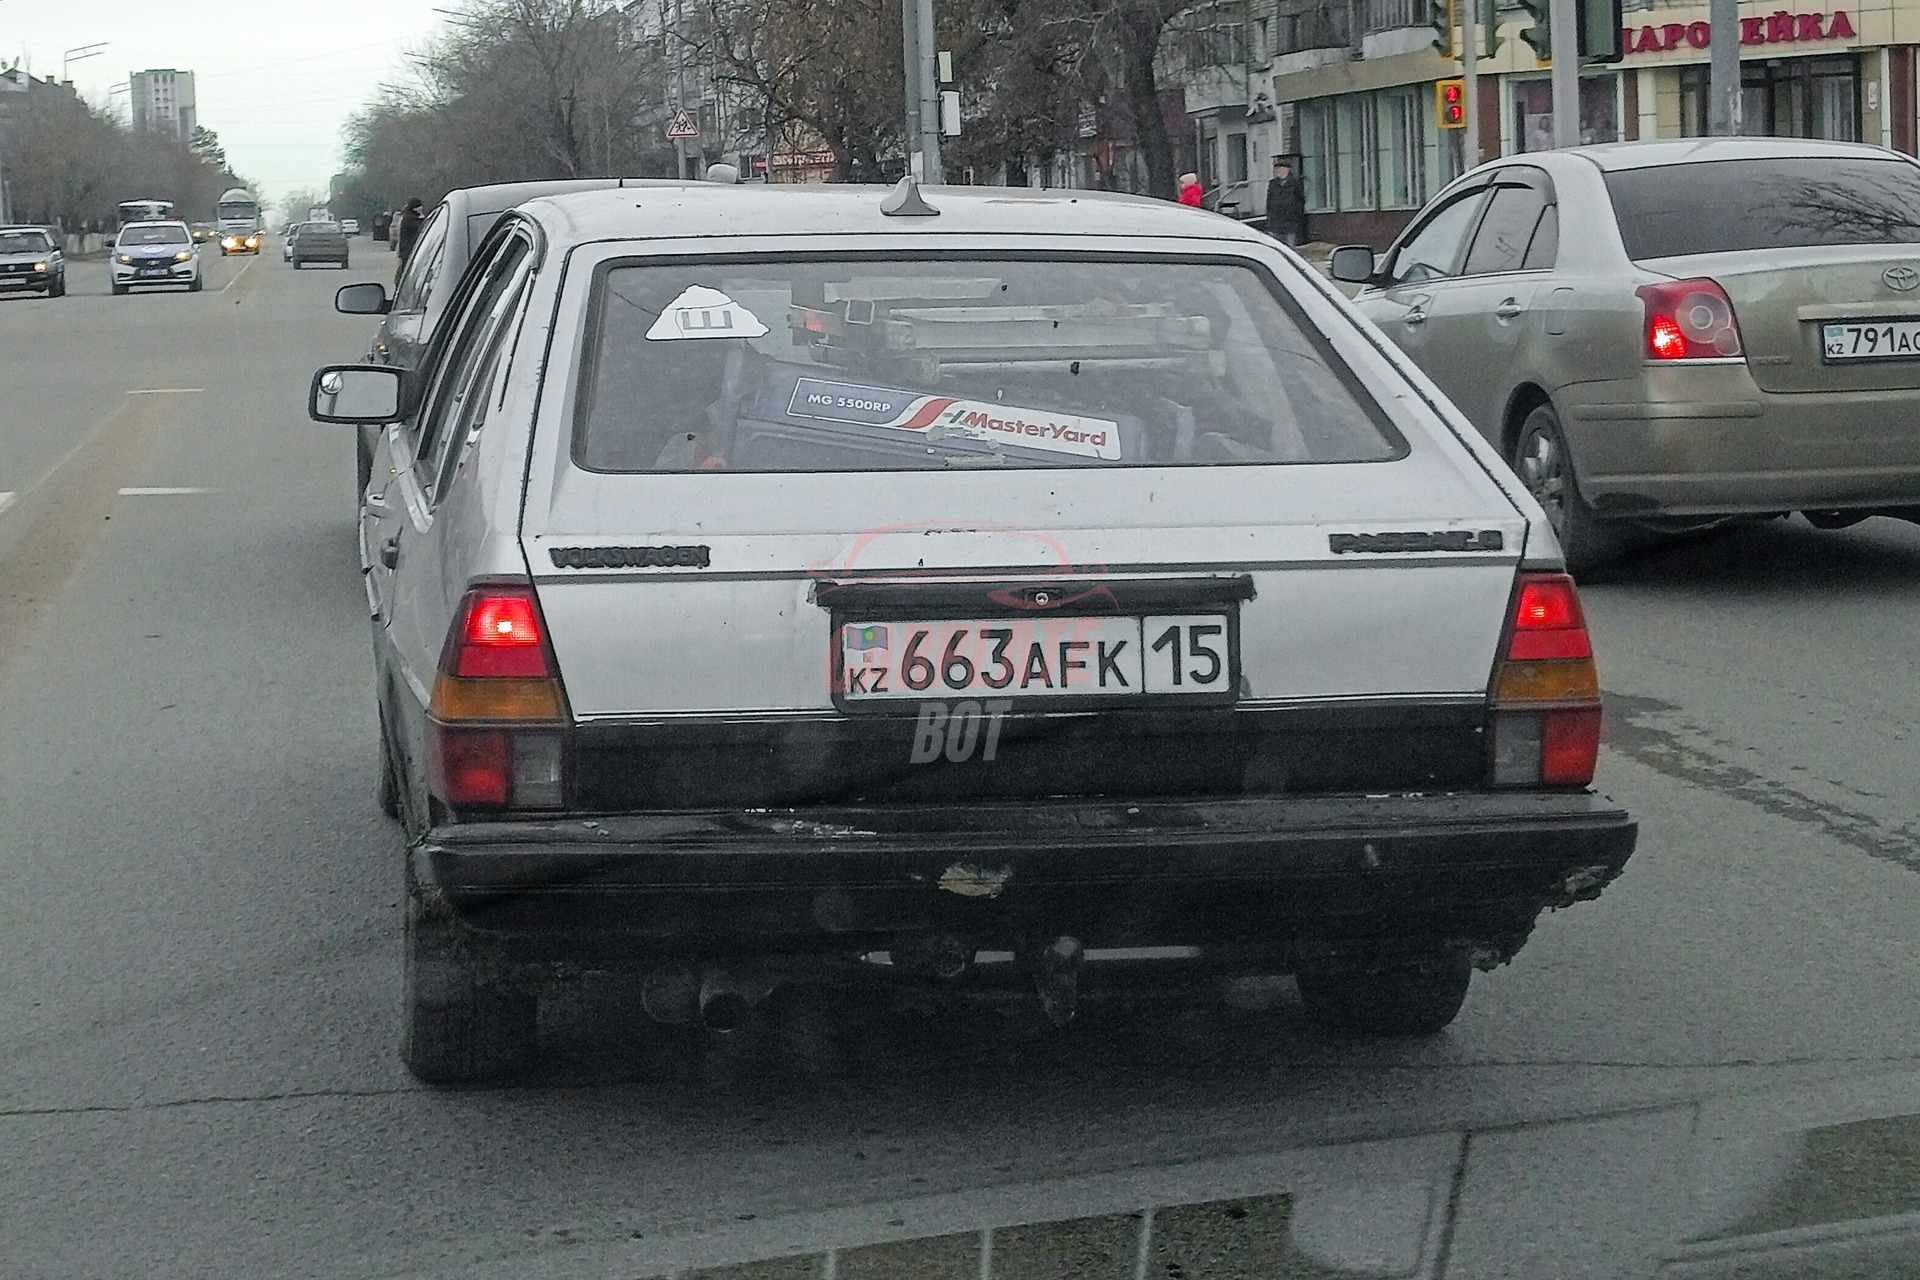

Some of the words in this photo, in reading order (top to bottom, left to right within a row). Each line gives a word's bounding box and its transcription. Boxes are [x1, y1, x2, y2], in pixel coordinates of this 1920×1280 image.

[1622, 11, 1856, 54] АРОЕЙКА
[1827, 343, 1844, 355] KZ
[808, 394, 833, 405] MG
[837, 397, 892, 413] 5500RP
[964, 411, 1107, 447] MasterYard
[901, 629, 1129, 690] 663AFK
[1152, 625, 1222, 685] 15
[849, 667, 889, 693] KZ
